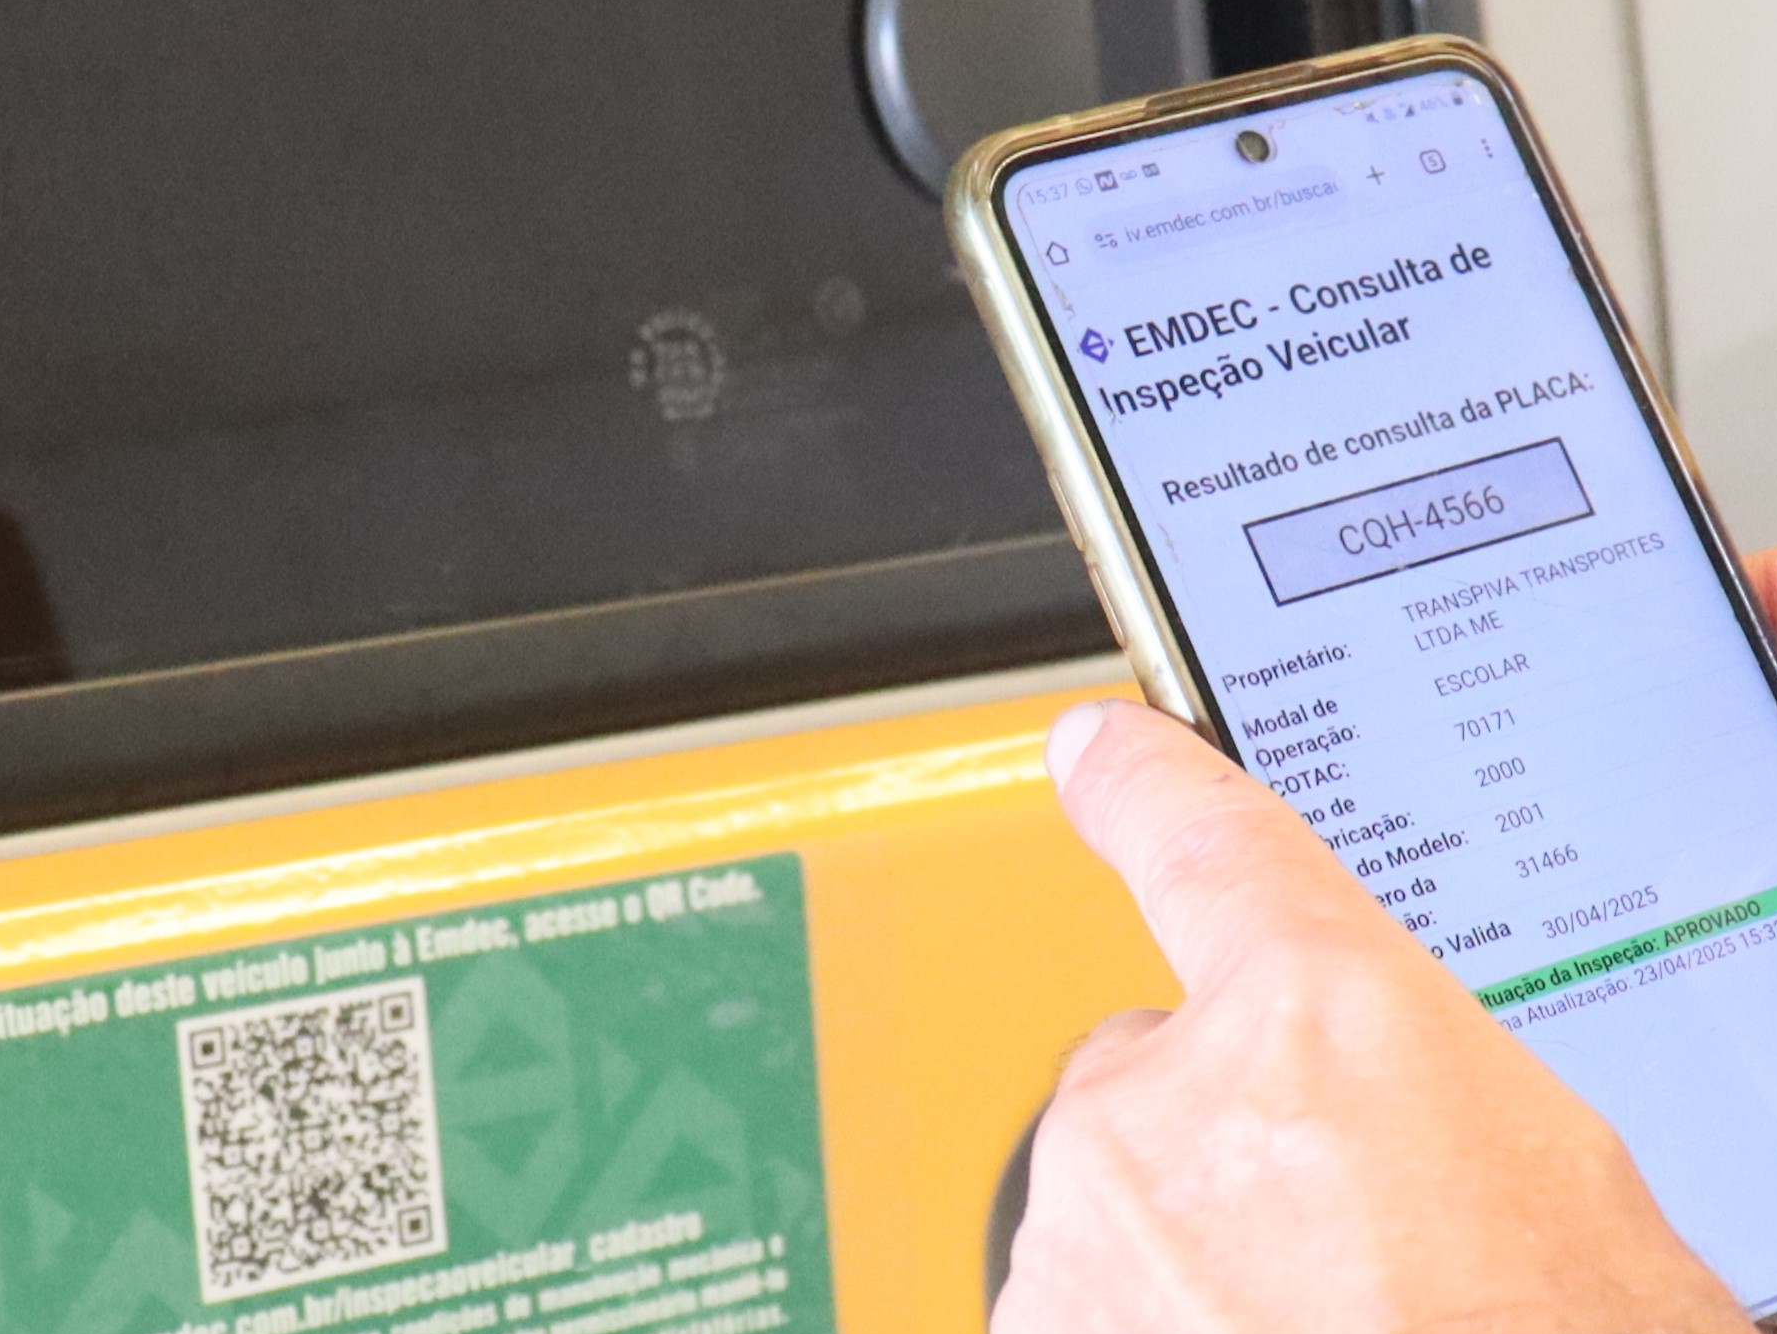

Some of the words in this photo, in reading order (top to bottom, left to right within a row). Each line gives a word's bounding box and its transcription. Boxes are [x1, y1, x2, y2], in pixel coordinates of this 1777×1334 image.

[1026, 182, 1068, 205] 15:37
[1125, 298, 1258, 358] EMDEC
[1290, 257, 1443, 316] Consulta
[1449, 240, 1494, 276] de
[1098, 351, 1264, 419] Inspeção
[1268, 311, 1413, 371] Veicular
[1163, 450, 1298, 506] Resultado
[1305, 439, 1338, 468] de
[1343, 410, 1455, 456] consulta
[1459, 391, 1493, 424] da
[1494, 370, 1595, 415] PLACA:
[1337, 485, 1507, 556] CQH-4566
[1401, 567, 1520, 625] TRANSPIVA
[1519, 532, 1665, 588] TRANSPORTES
[1413, 618, 1468, 652] LTDA
[1468, 610, 1505, 636] ME
[1221, 642, 1352, 696] Proprietário:
[1433, 654, 1531, 698] ESCOLAR
[1241, 701, 1311, 741] Modal
[1312, 696, 1340, 719] de
[1453, 708, 1518, 745] 70171
[1254, 721, 1362, 771] Operação:
[1474, 756, 1527, 790] 2000
[1299, 806, 1325, 827] no
[1330, 796, 1356, 817] de
[1494, 802, 1546, 834] 2001
[1357, 856, 1382, 878] do
[1386, 828, 1469, 867] Modelo:
[1515, 843, 1579, 880] 31466
[1411, 876, 1437, 899] da
[1541, 884, 1660, 940] 30/04/2025
[114, 969, 196, 1018] deste
[201, 946, 308, 1003] veículo
[314, 937, 386, 986] junto
[392, 930, 411, 968] à
[415, 915, 520, 964] Emdec,
[524, 894, 618, 945] acesse
[624, 892, 643, 925] o
[646, 879, 684, 923] QR
[687, 868, 764, 912] Code.
[1447, 920, 1512, 954] Valida
[1481, 974, 1547, 1009] ituação
[1550, 967, 1572, 988] da
[1574, 935, 1660, 978] Inspeção:
[1662, 898, 1762, 948] APROVADO
[1527, 975, 1633, 1025] Atualização:
[1633, 936, 1738, 989] 23/04/2025
